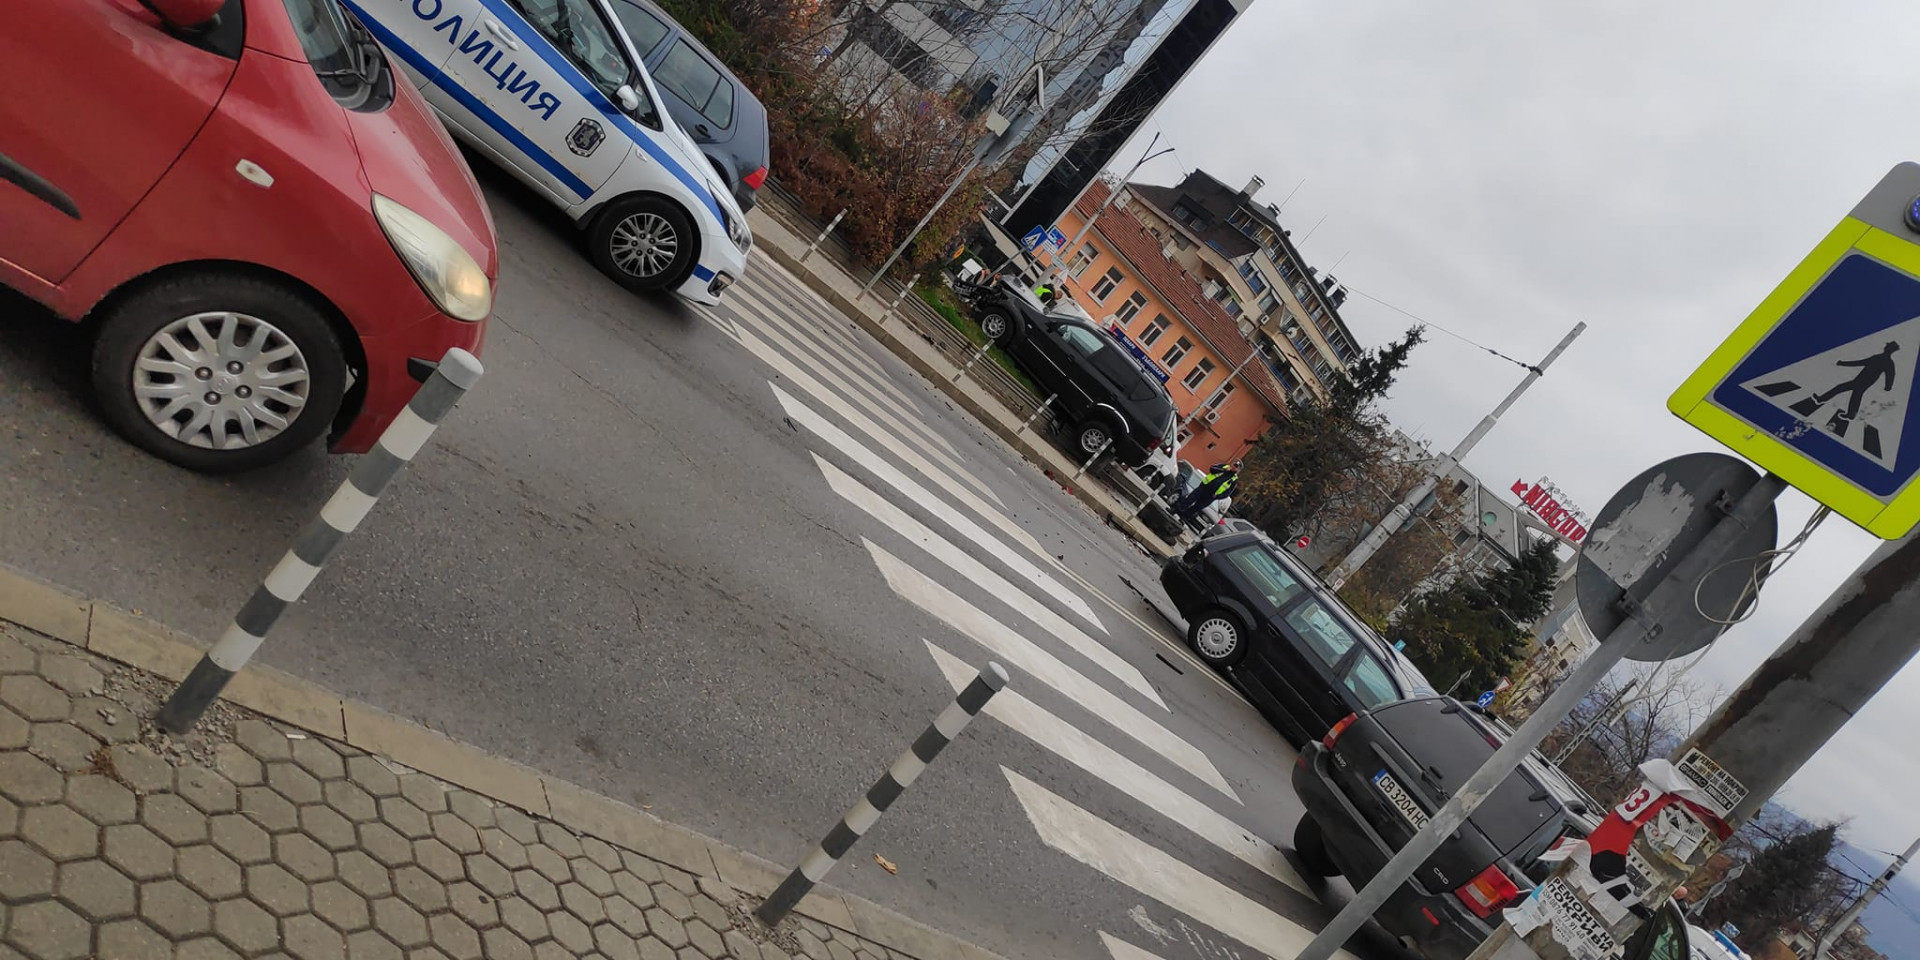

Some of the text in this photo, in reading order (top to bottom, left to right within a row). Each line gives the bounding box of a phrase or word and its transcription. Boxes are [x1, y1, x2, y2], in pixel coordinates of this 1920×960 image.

[400, 0, 562, 121] ОЛИЦИЯ
[1522, 483, 1587, 546] NIAGAR
[1334, 752, 1347, 767] Jeep
[1433, 867, 1449, 885] CRD
[1547, 882, 1610, 953] ПОКРИВИ
[1552, 877, 1601, 930] РЕМОНТ
[1600, 932, 1615, 950] НА
